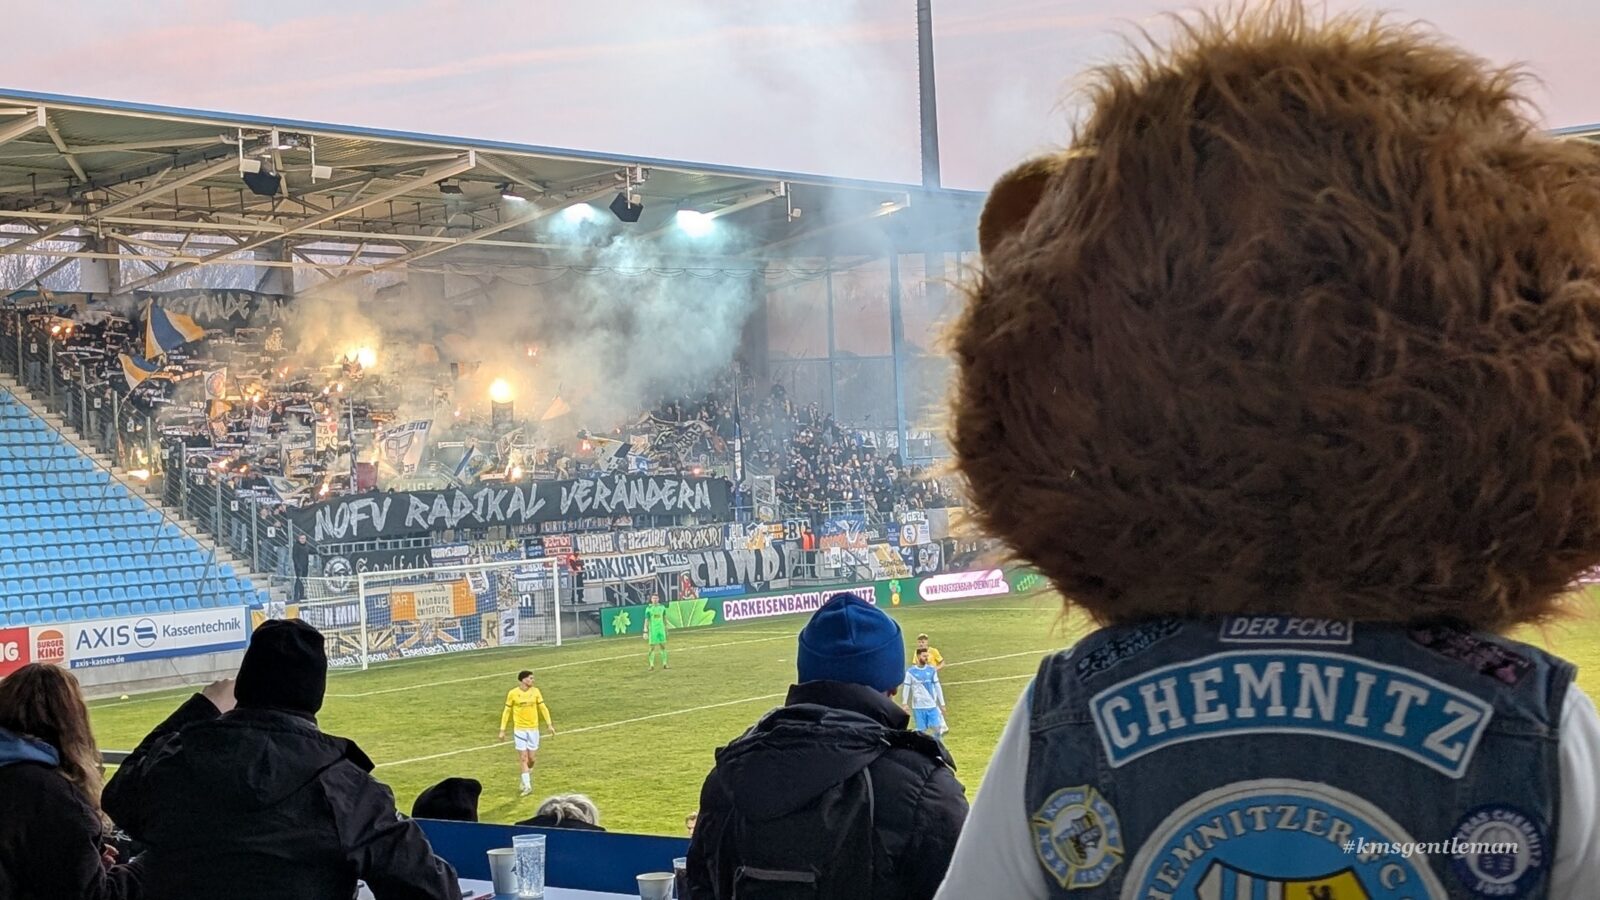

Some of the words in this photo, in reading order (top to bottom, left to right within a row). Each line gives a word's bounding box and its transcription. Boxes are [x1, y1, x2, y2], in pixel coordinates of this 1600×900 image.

[314, 495, 391, 542] NOFV
[405, 483, 546, 531] RADIKAL
[560, 470, 711, 516] VERÄNDERN
[724, 594, 820, 619] PARKEISENBAHN
[822, 589, 875, 604] CNITZ
[75, 625, 130, 650] AXIS
[162, 617, 241, 637] Kassentechnik
[1230, 617, 1276, 636] DER
[37, 640, 64, 648] BURGER
[37, 647, 64, 658] KING
[74, 656, 125, 668] axis-kassen.de
[1101, 661, 1482, 762] CHEMNITZ
